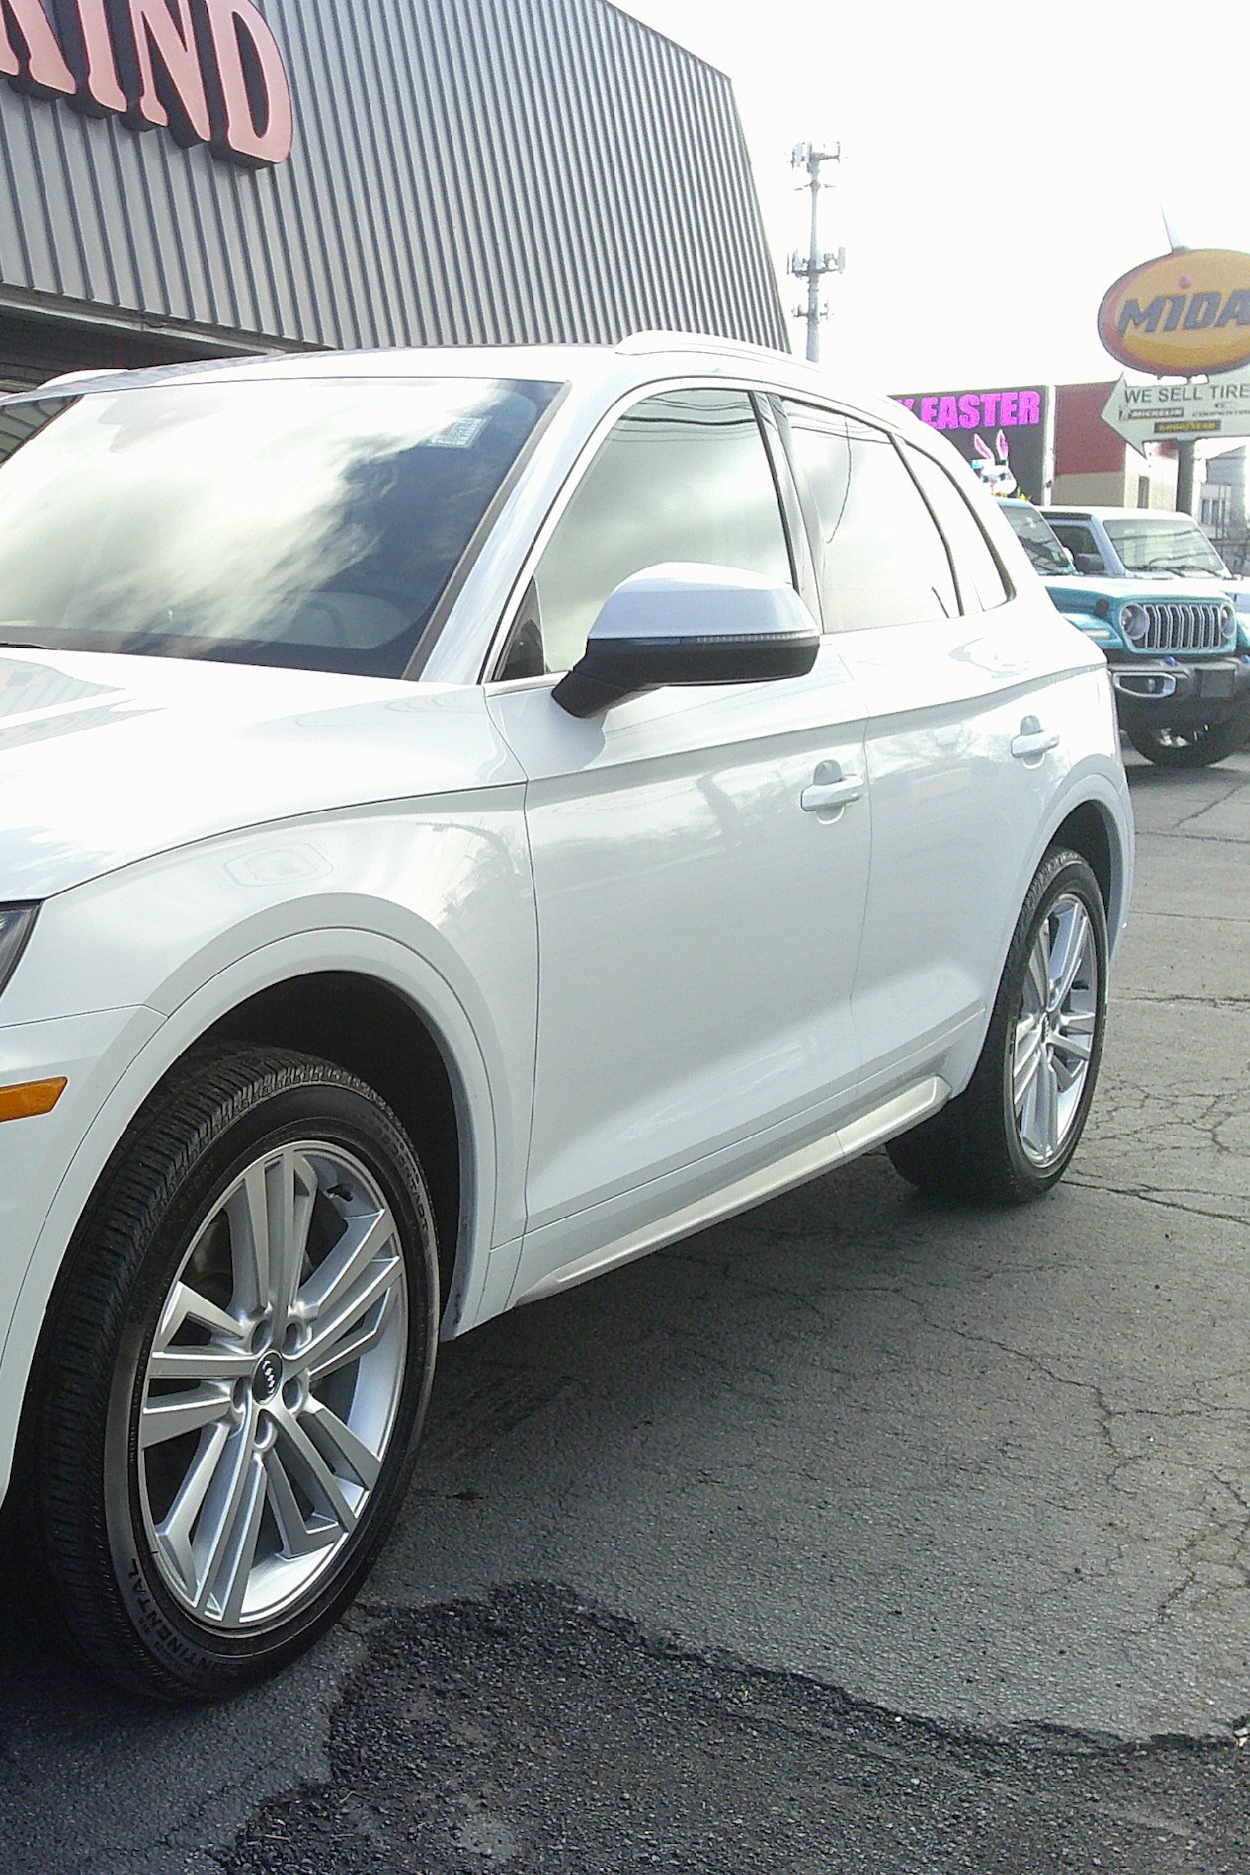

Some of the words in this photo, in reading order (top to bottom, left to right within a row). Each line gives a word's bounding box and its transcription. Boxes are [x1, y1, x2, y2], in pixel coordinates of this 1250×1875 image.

[1124, 389, 1152, 403] WE
[1158, 387, 1203, 402] SELL
[1210, 383, 1250, 399] TIRE
[921, 390, 1040, 430] EASTER
